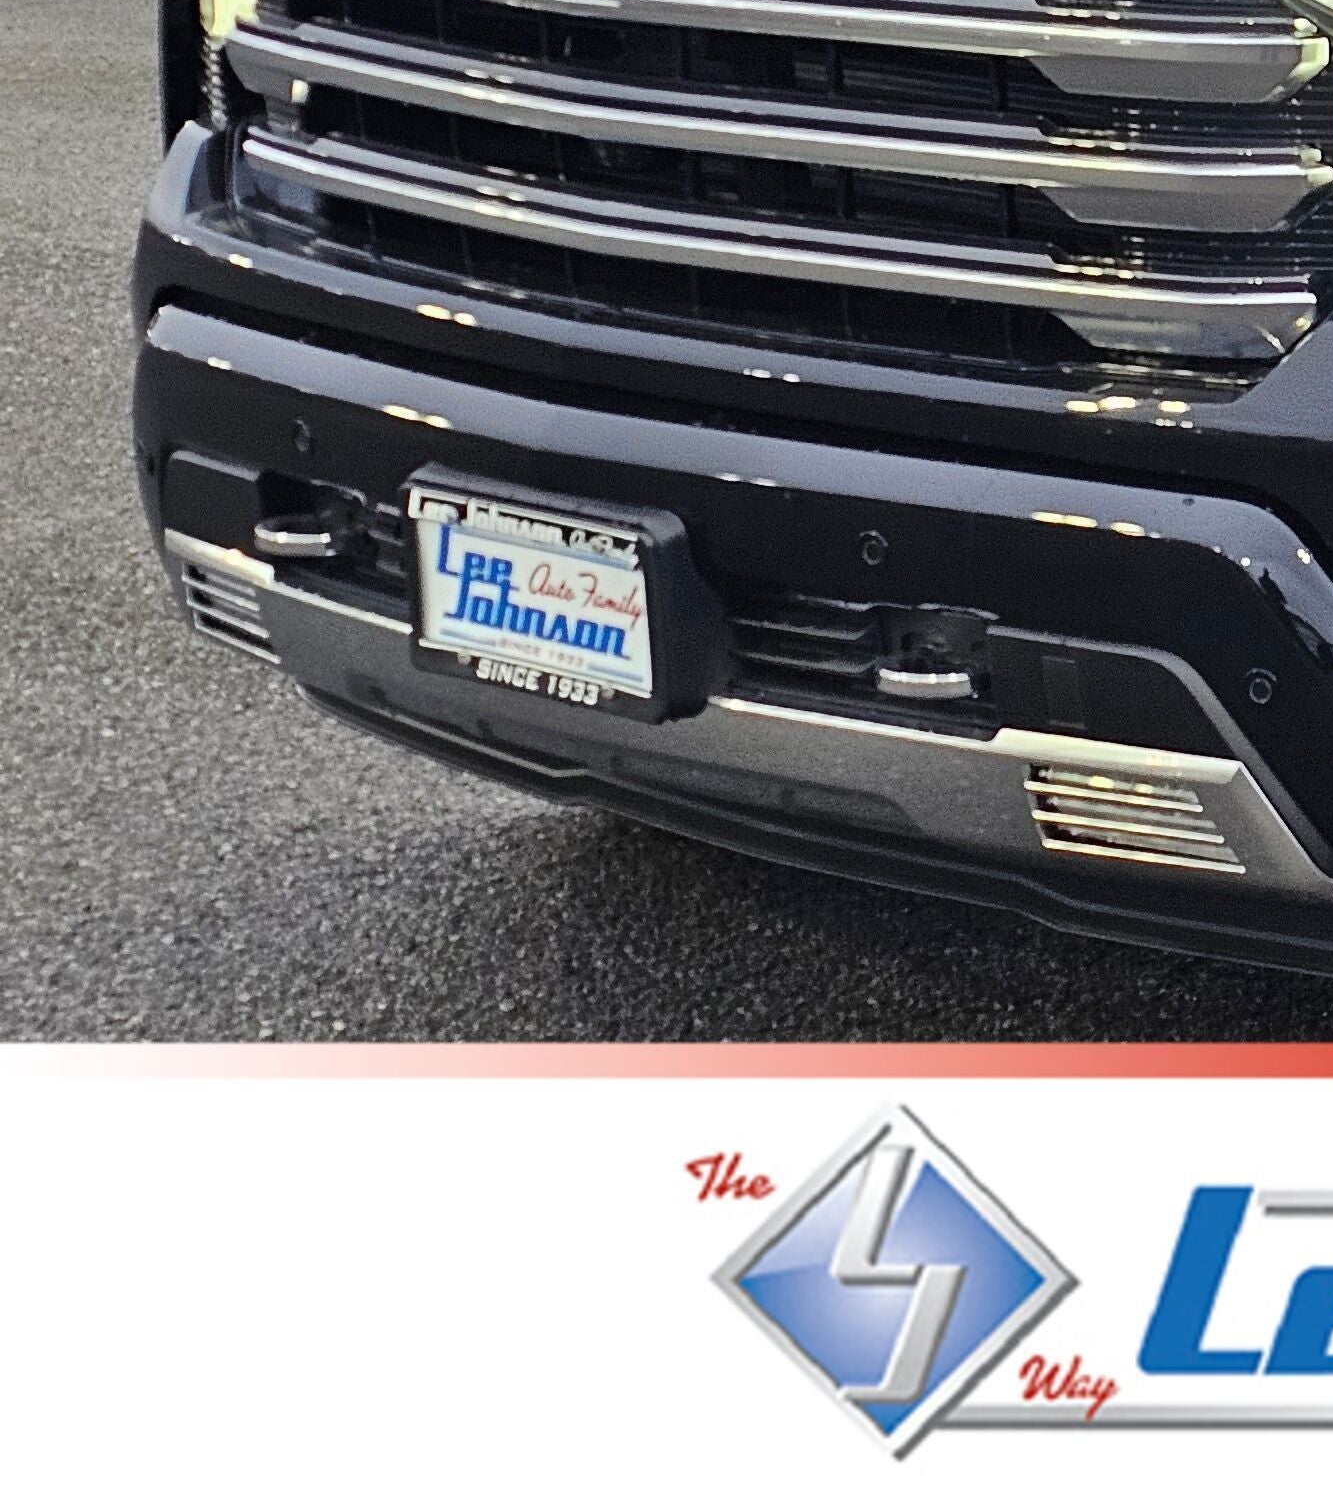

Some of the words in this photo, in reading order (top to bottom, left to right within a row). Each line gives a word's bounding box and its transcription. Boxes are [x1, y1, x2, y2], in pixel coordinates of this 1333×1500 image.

[437, 522, 520, 591] Lee
[443, 578, 632, 661] Johnson
[475, 656, 543, 691] SINCE
[547, 673, 600, 706] 1933
